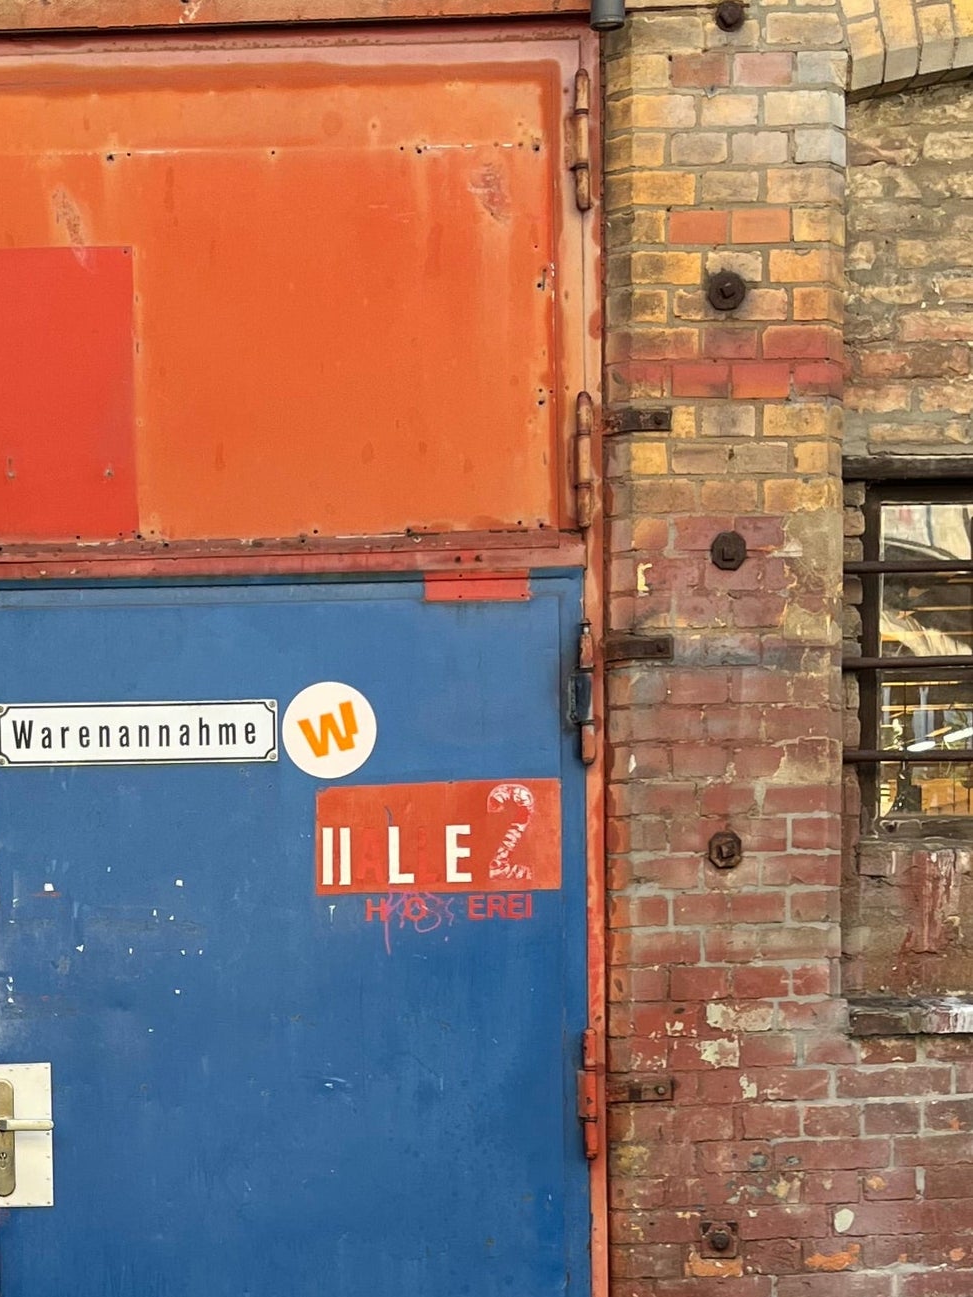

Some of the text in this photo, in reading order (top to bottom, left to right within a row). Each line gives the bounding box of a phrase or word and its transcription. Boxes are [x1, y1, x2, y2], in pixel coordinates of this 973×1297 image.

[12, 717, 257, 750] Warenannahme
[297, 700, 359, 759] W
[486, 783, 536, 880] 2
